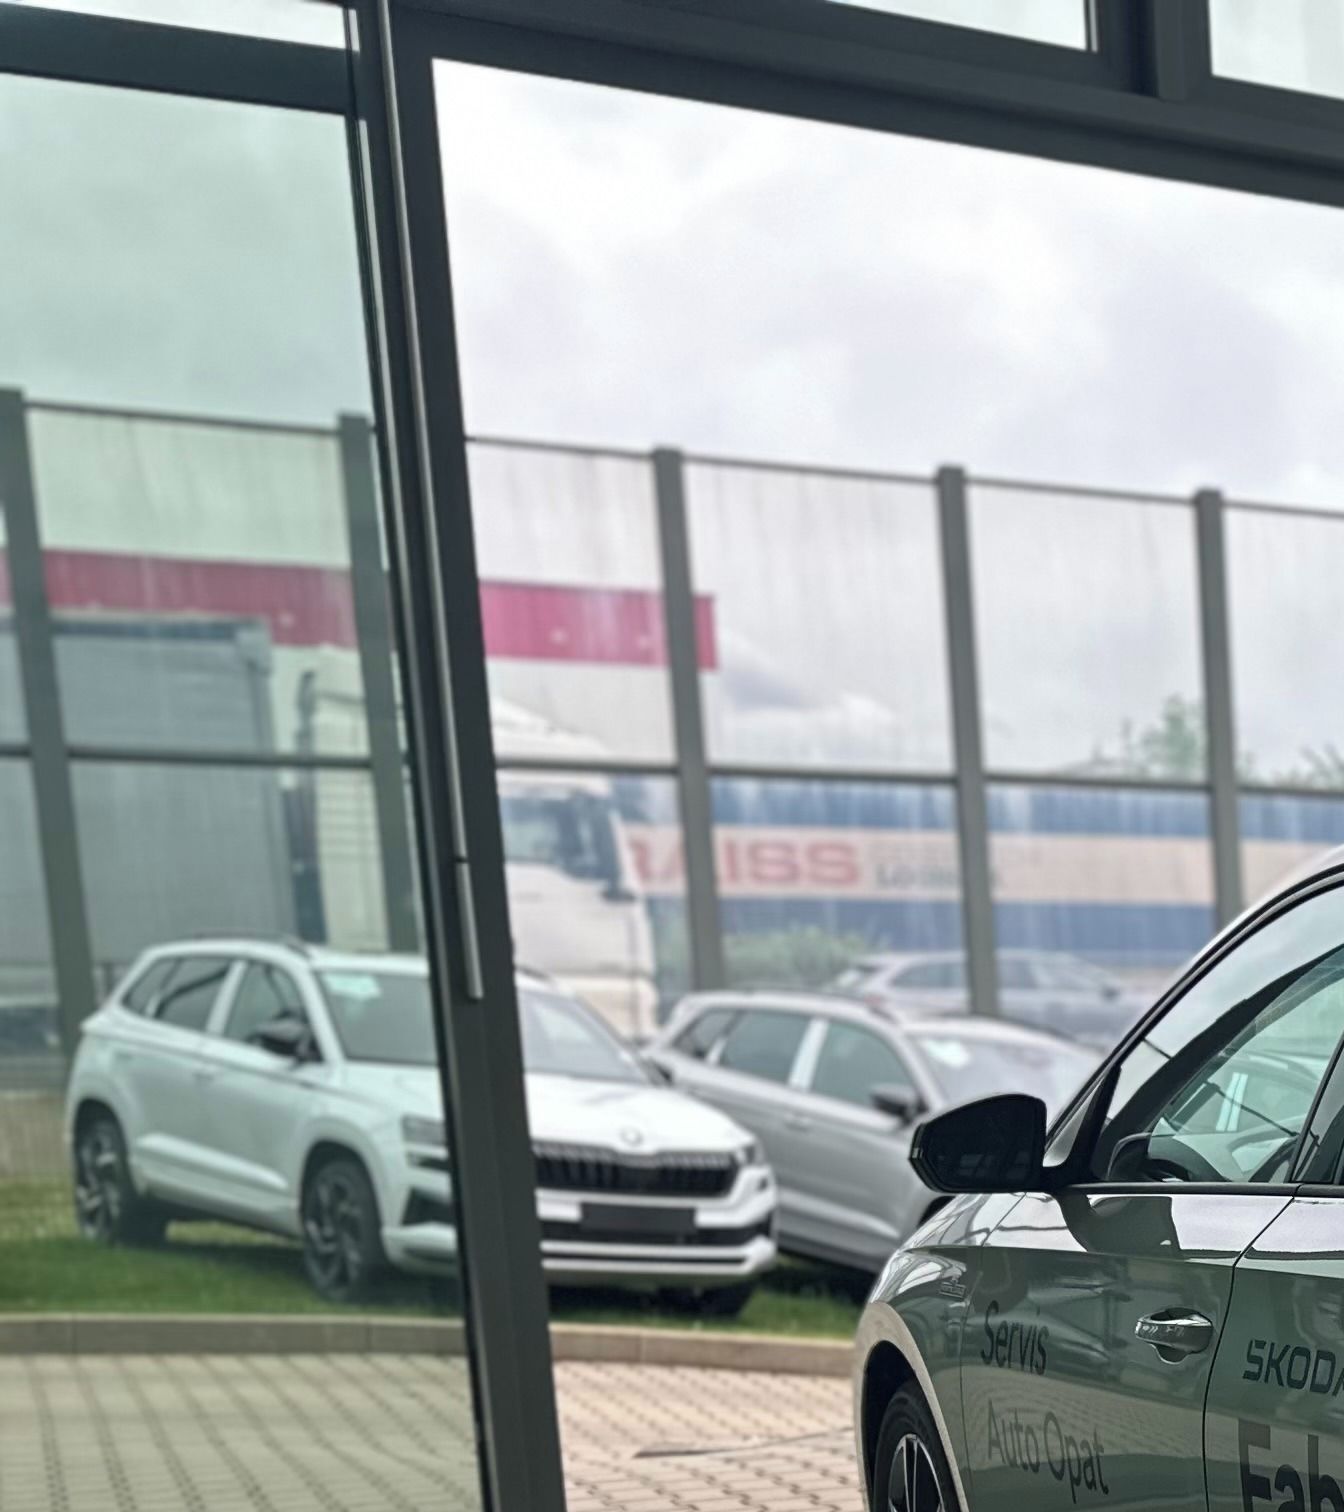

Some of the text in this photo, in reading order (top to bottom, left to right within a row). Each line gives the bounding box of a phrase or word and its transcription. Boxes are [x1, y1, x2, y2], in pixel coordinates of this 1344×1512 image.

[981, 1300, 1050, 1376] Servis
[988, 1400, 1110, 1504] Auto Opat
